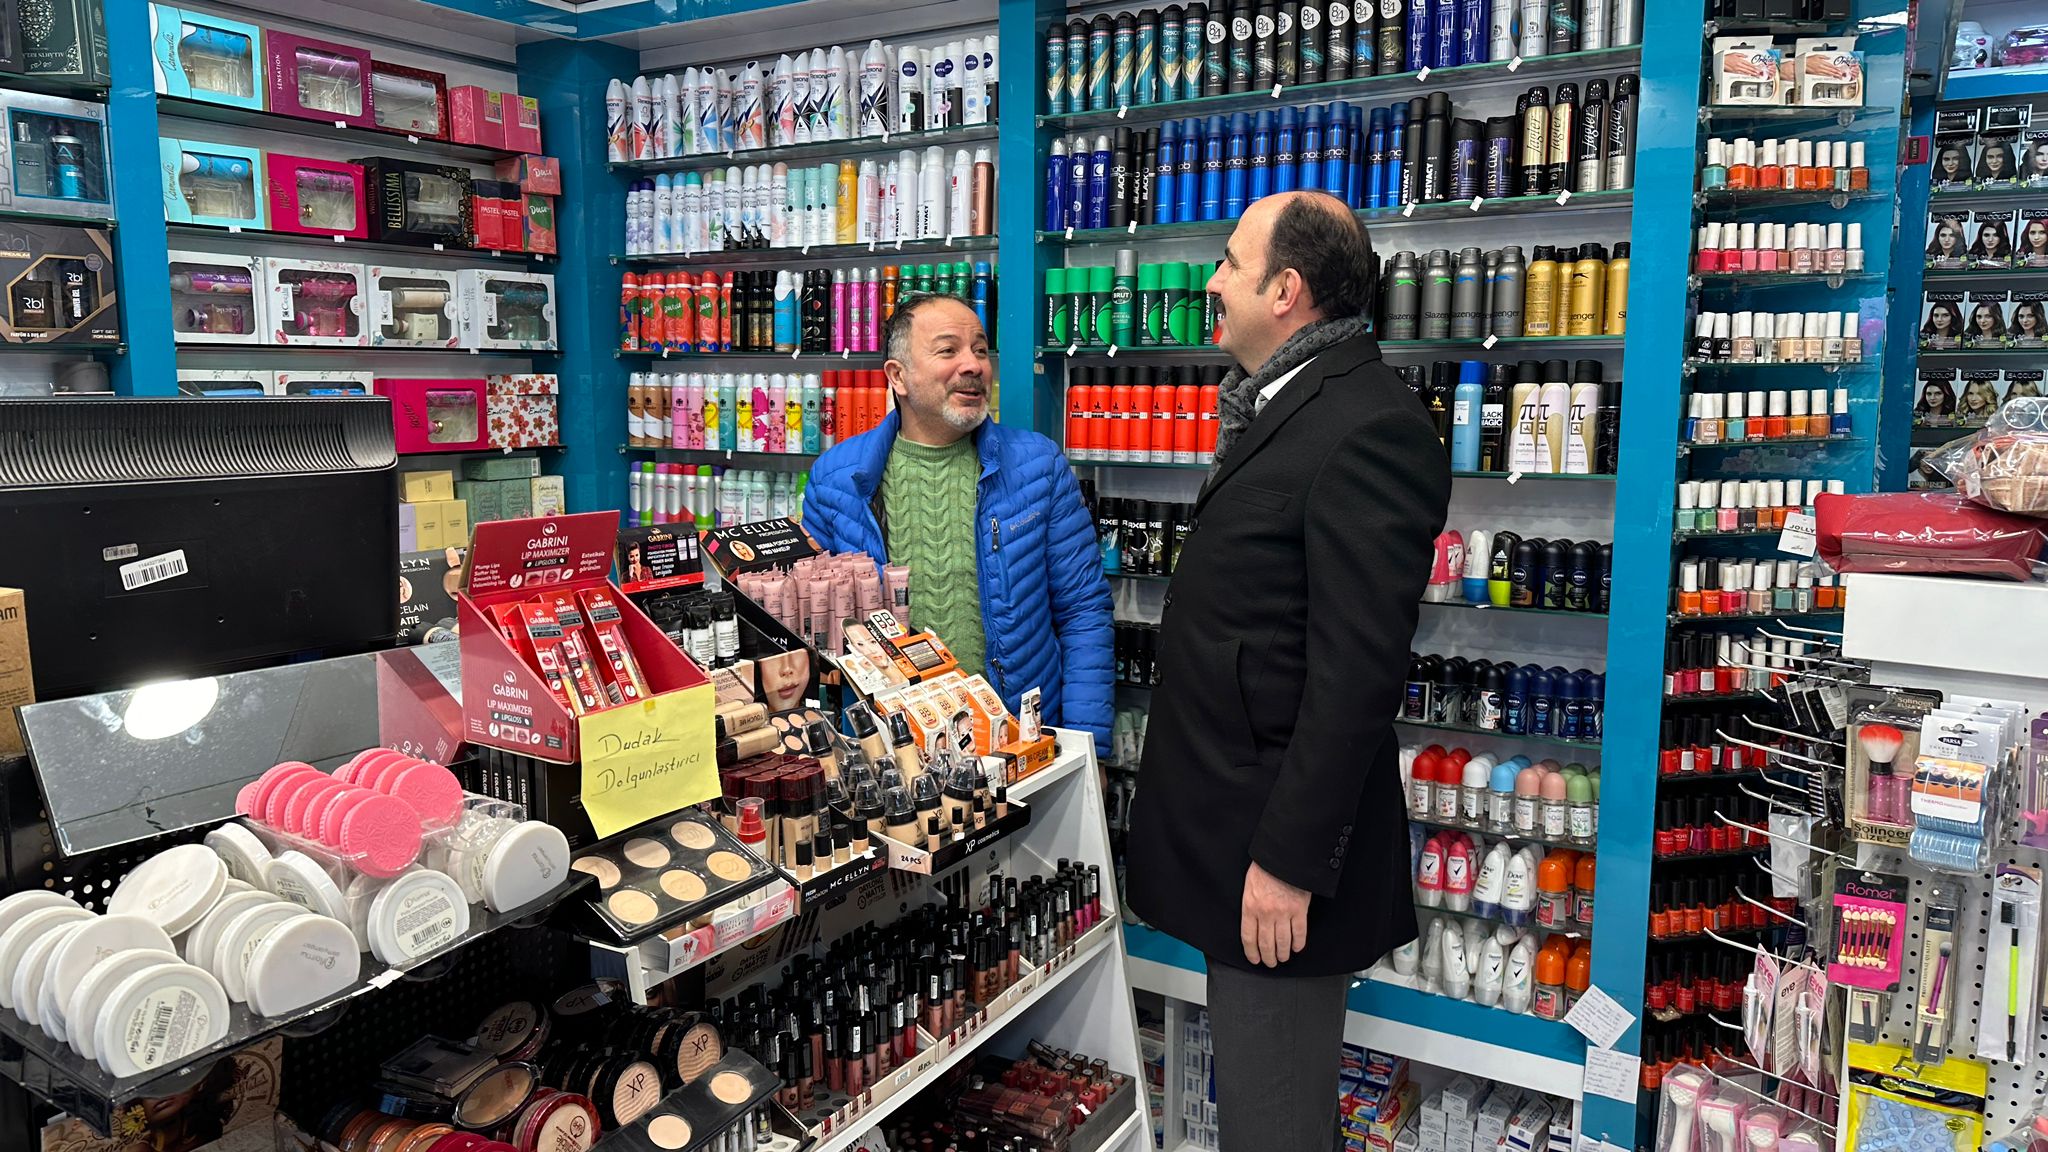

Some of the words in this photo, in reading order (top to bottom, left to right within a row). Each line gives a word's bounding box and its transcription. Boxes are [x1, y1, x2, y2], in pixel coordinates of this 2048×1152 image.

[1324, 148, 1349, 157] snob
[1488, 143, 1497, 168] CLASS
[1117, 174, 1125, 199] BLACK
[1402, 168, 1410, 204] PRIVACY
[1425, 162, 1434, 199] PRIVACY
[1487, 170, 1496, 194] FIRST
[480, 206, 500, 214] PASTEL
[501, 209, 519, 217] PASTEL
[66, 272, 83, 282] Rbl
[22, 297, 45, 309] Rbl
[462, 287, 470, 321] Cecile
[1100, 518, 1118, 526] AXE
[1128, 521, 1146, 529] AXE
[1789, 524, 1816, 534] JOLLY
[714, 527, 741, 541] MC
[743, 519, 789, 535] ELLYN
[527, 535, 568, 550] GABRINI
[647, 533, 673, 543] GABRINI
[755, 541, 773, 550] DERMA
[771, 537, 799, 547] PORCELAIN
[521, 551, 532, 560] LIP
[533, 547, 570, 559] MAXIMIZER
[771, 546, 791, 554] MAKEUP
[534, 558, 557, 567] LIPGLOSS
[590, 600, 613, 609] GABRINI
[529, 614, 555, 624] GABRINI
[873, 611, 896, 628] BB
[493, 684, 529, 700] GABRINI
[487, 700, 499, 708] LIP
[499, 701, 533, 716] MAXIMIZER
[939, 700, 952, 711] BB
[1898, 697, 1934, 707] Solingen
[501, 713, 522, 724] LIPGLOSS
[918, 708, 931, 718] BB
[593, 728, 680, 762] Dudak
[1942, 737, 1962, 746] PARSA
[1033, 746, 1049, 763] CREAM
[979, 789, 989, 800] XP
[932, 808, 943, 818] XP
[975, 816, 984, 824] XP
[965, 840, 976, 854] XP
[977, 829, 1000, 845] cosmetics
[900, 855, 909, 863] 24
[910, 856, 922, 865] PCS
[829, 877, 844, 890] MC
[845, 864, 869, 883] ELLYN
[1507, 871, 1524, 880] Dove
[858, 876, 884, 895] DAYLONG
[865, 883, 886, 899] MATTE
[805, 888, 829, 903] FOUNDATION
[739, 945, 771, 966] DAYLONG
[1924, 939, 1932, 961] QUALITY
[743, 952, 769, 973] MATTE
[1757, 957, 1774, 985] eye
[1781, 981, 1796, 998] eye
[1809, 975, 1823, 998] eye
[692, 1033, 709, 1056] XP
[627, 1073, 646, 1098] XP
